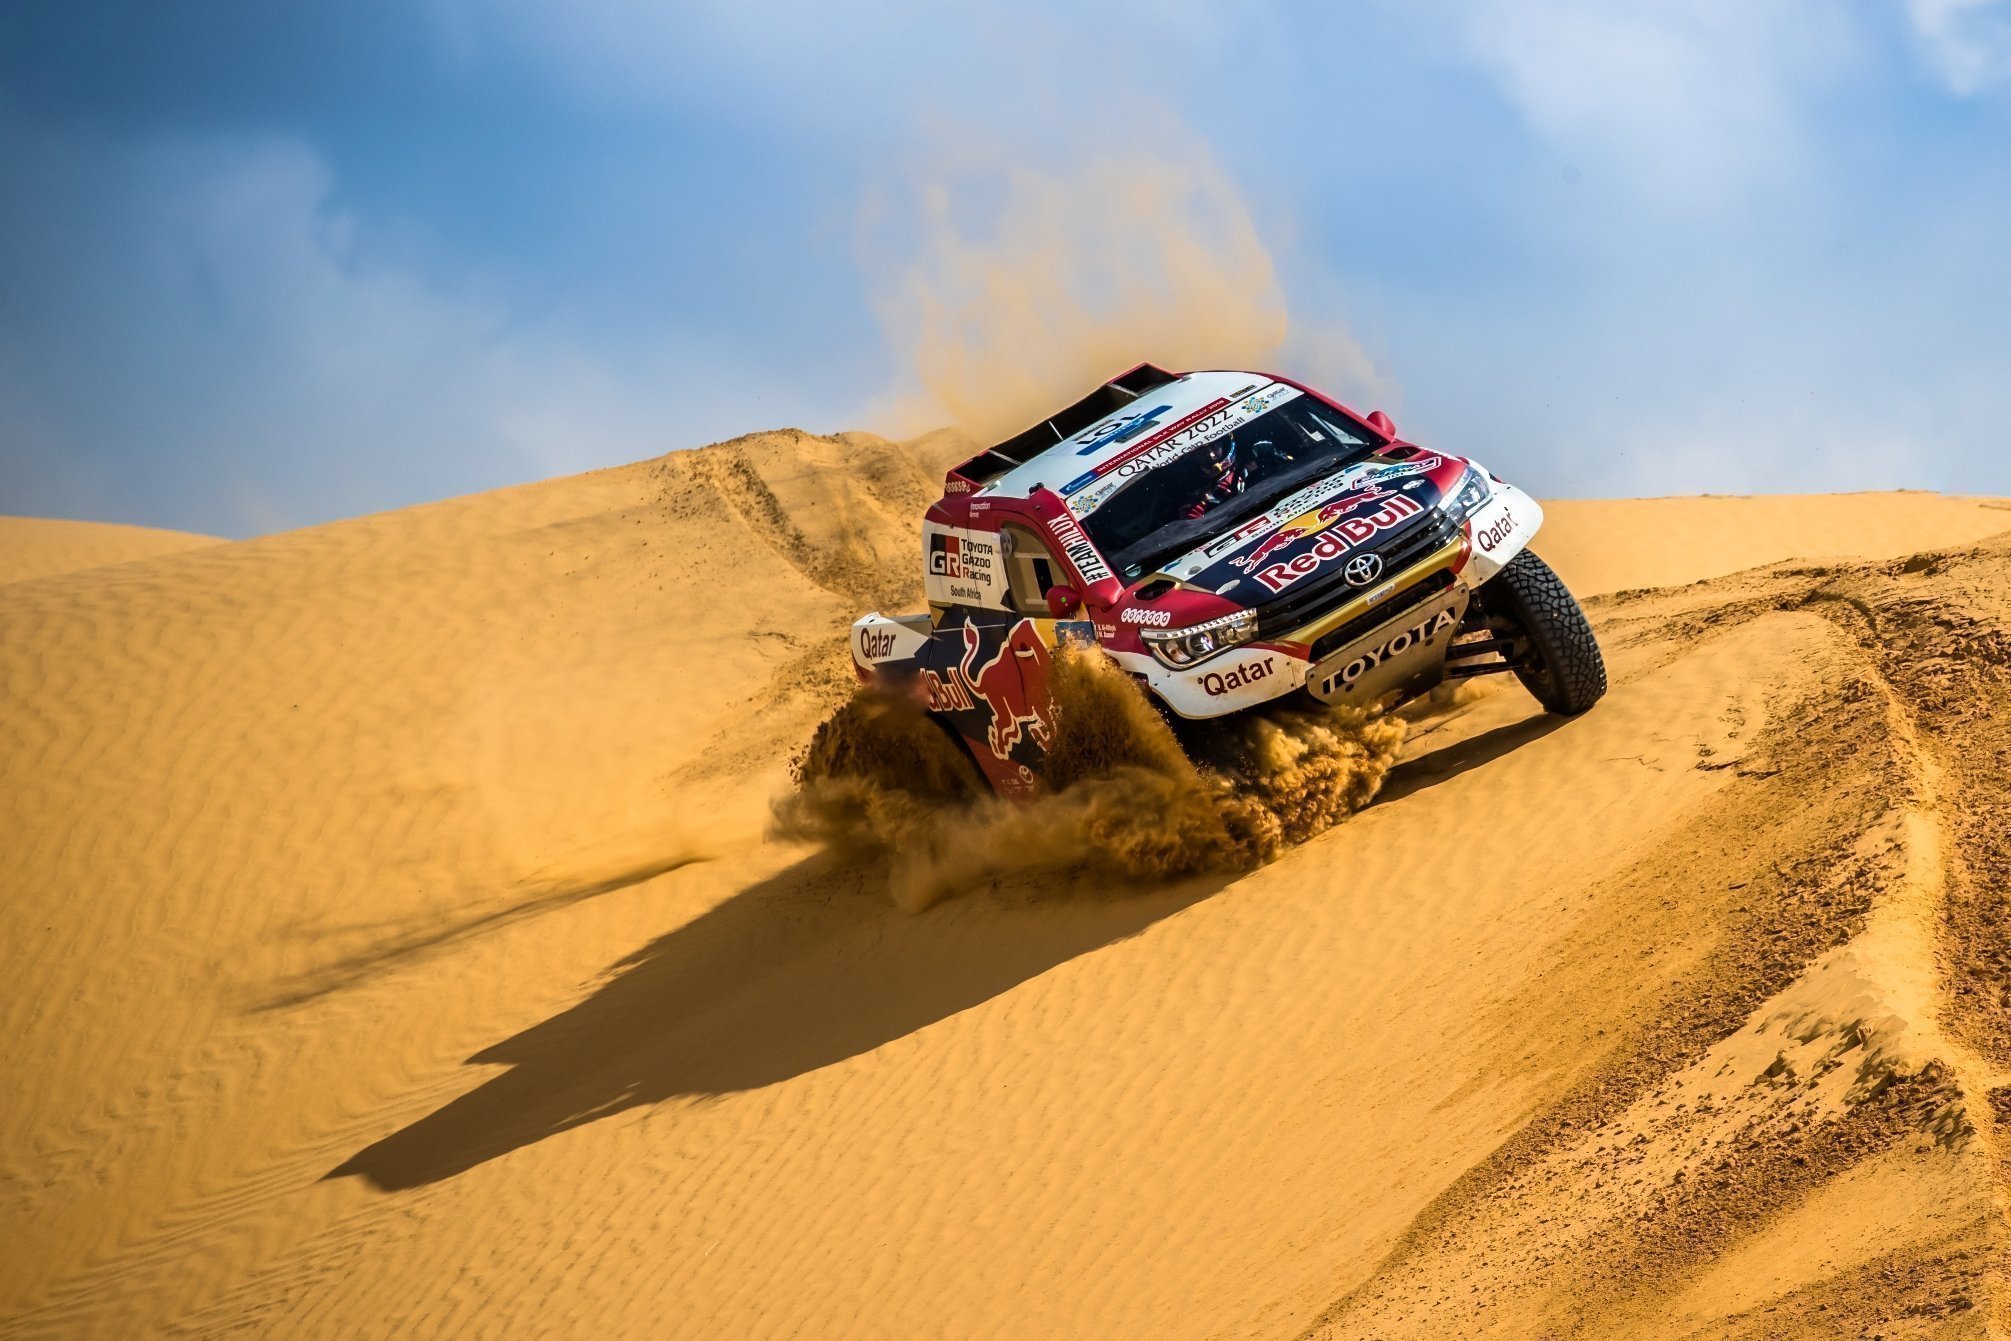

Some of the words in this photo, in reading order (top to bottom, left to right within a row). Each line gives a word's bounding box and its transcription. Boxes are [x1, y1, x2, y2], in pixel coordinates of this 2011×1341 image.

[1097, 440, 1154, 472] INTERNATIONAL
[1185, 408, 1208, 418] RALLY
[1118, 439, 1183, 477] QATAR
[1184, 409, 1234, 440] 2022
[1204, 416, 1246, 441] Football
[961, 539, 993, 555] TOYOTA
[1047, 512, 1109, 582] #TEAMHILUX
[1251, 519, 1284, 538] South
[1254, 531, 1350, 594] Red
[1333, 494, 1424, 547] Bull
[1477, 511, 1518, 552] Qatar
[962, 553, 991, 568] GAZOO
[963, 566, 992, 586] Racing
[950, 585, 966, 598] South
[967, 588, 982, 600] Africa
[860, 627, 897, 660] Qatar
[1322, 607, 1456, 695] TOYOTA
[1203, 656, 1274, 697] Qatar
